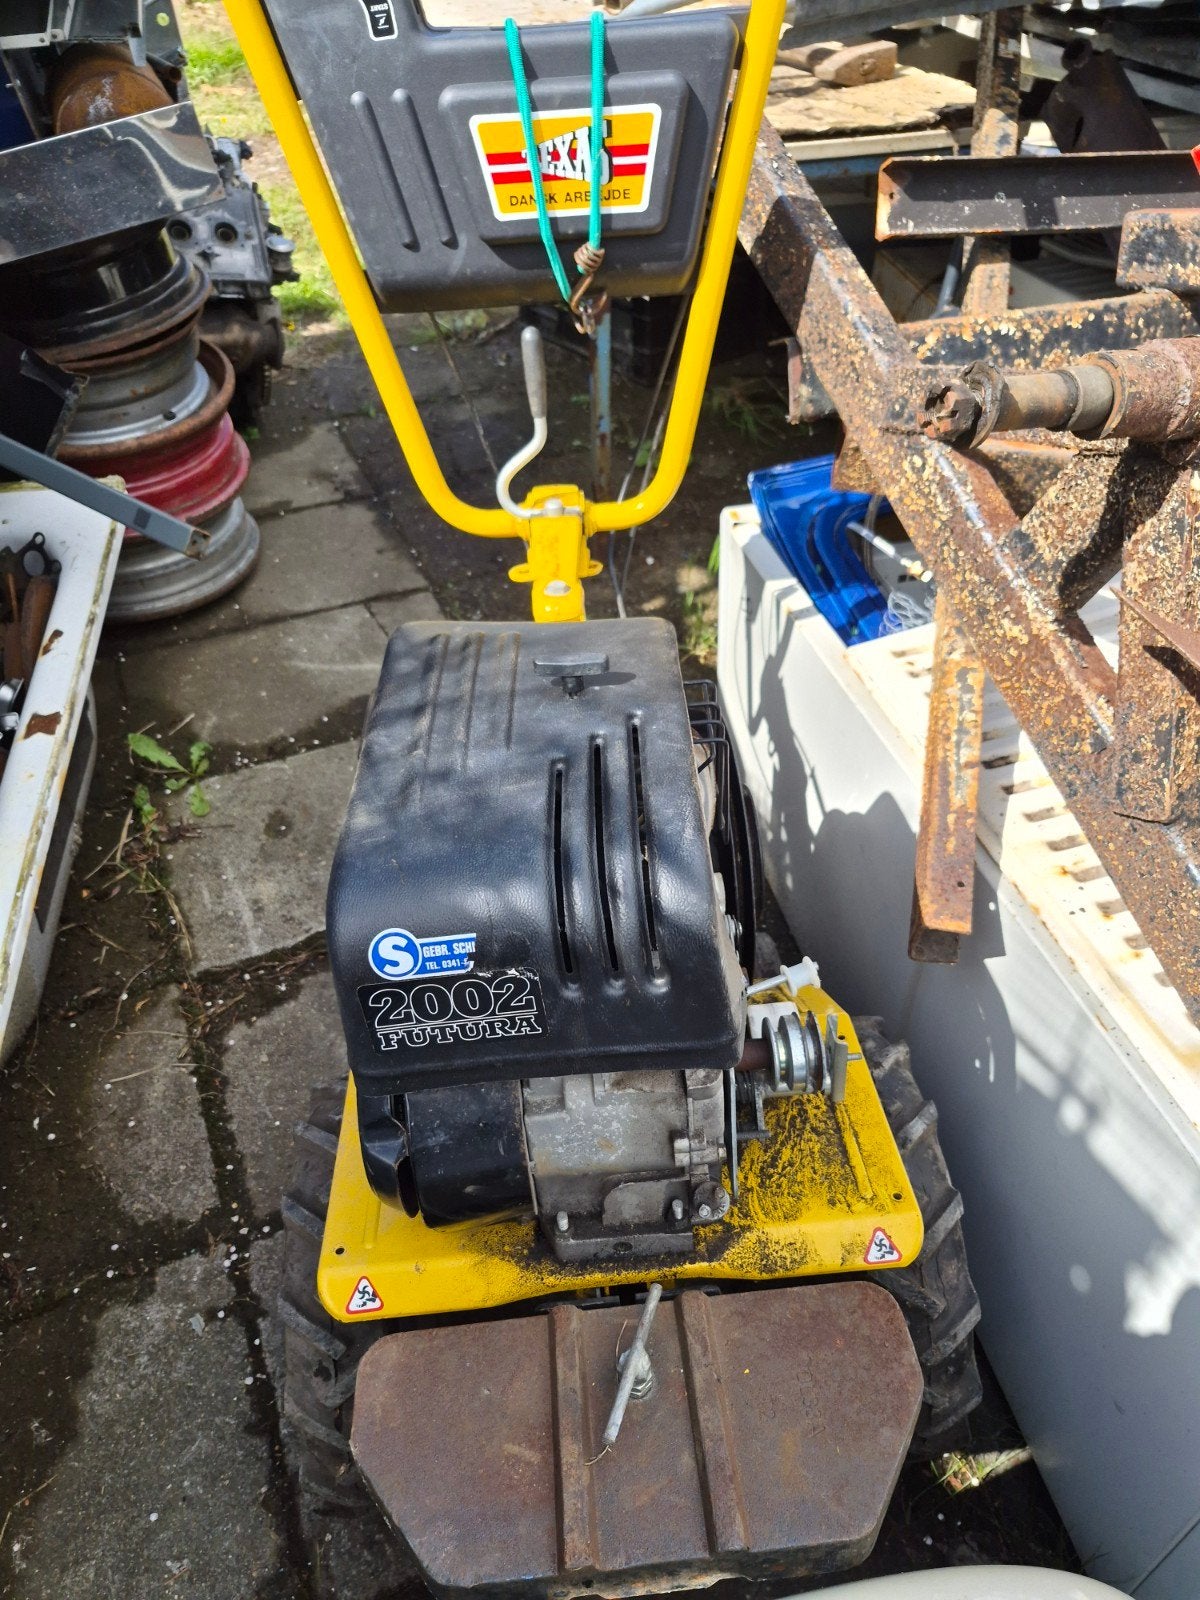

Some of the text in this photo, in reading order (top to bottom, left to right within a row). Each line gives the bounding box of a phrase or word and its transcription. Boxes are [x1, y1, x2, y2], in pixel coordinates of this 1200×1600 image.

[509, 188, 630, 206] DANK ARBJDE
[378, 935, 415, 975] S
[423, 944, 452, 958] GEBR.
[425, 961, 441, 970] TEL.
[369, 975, 537, 1028] 2002
[377, 1015, 542, 1050] FUTURA
